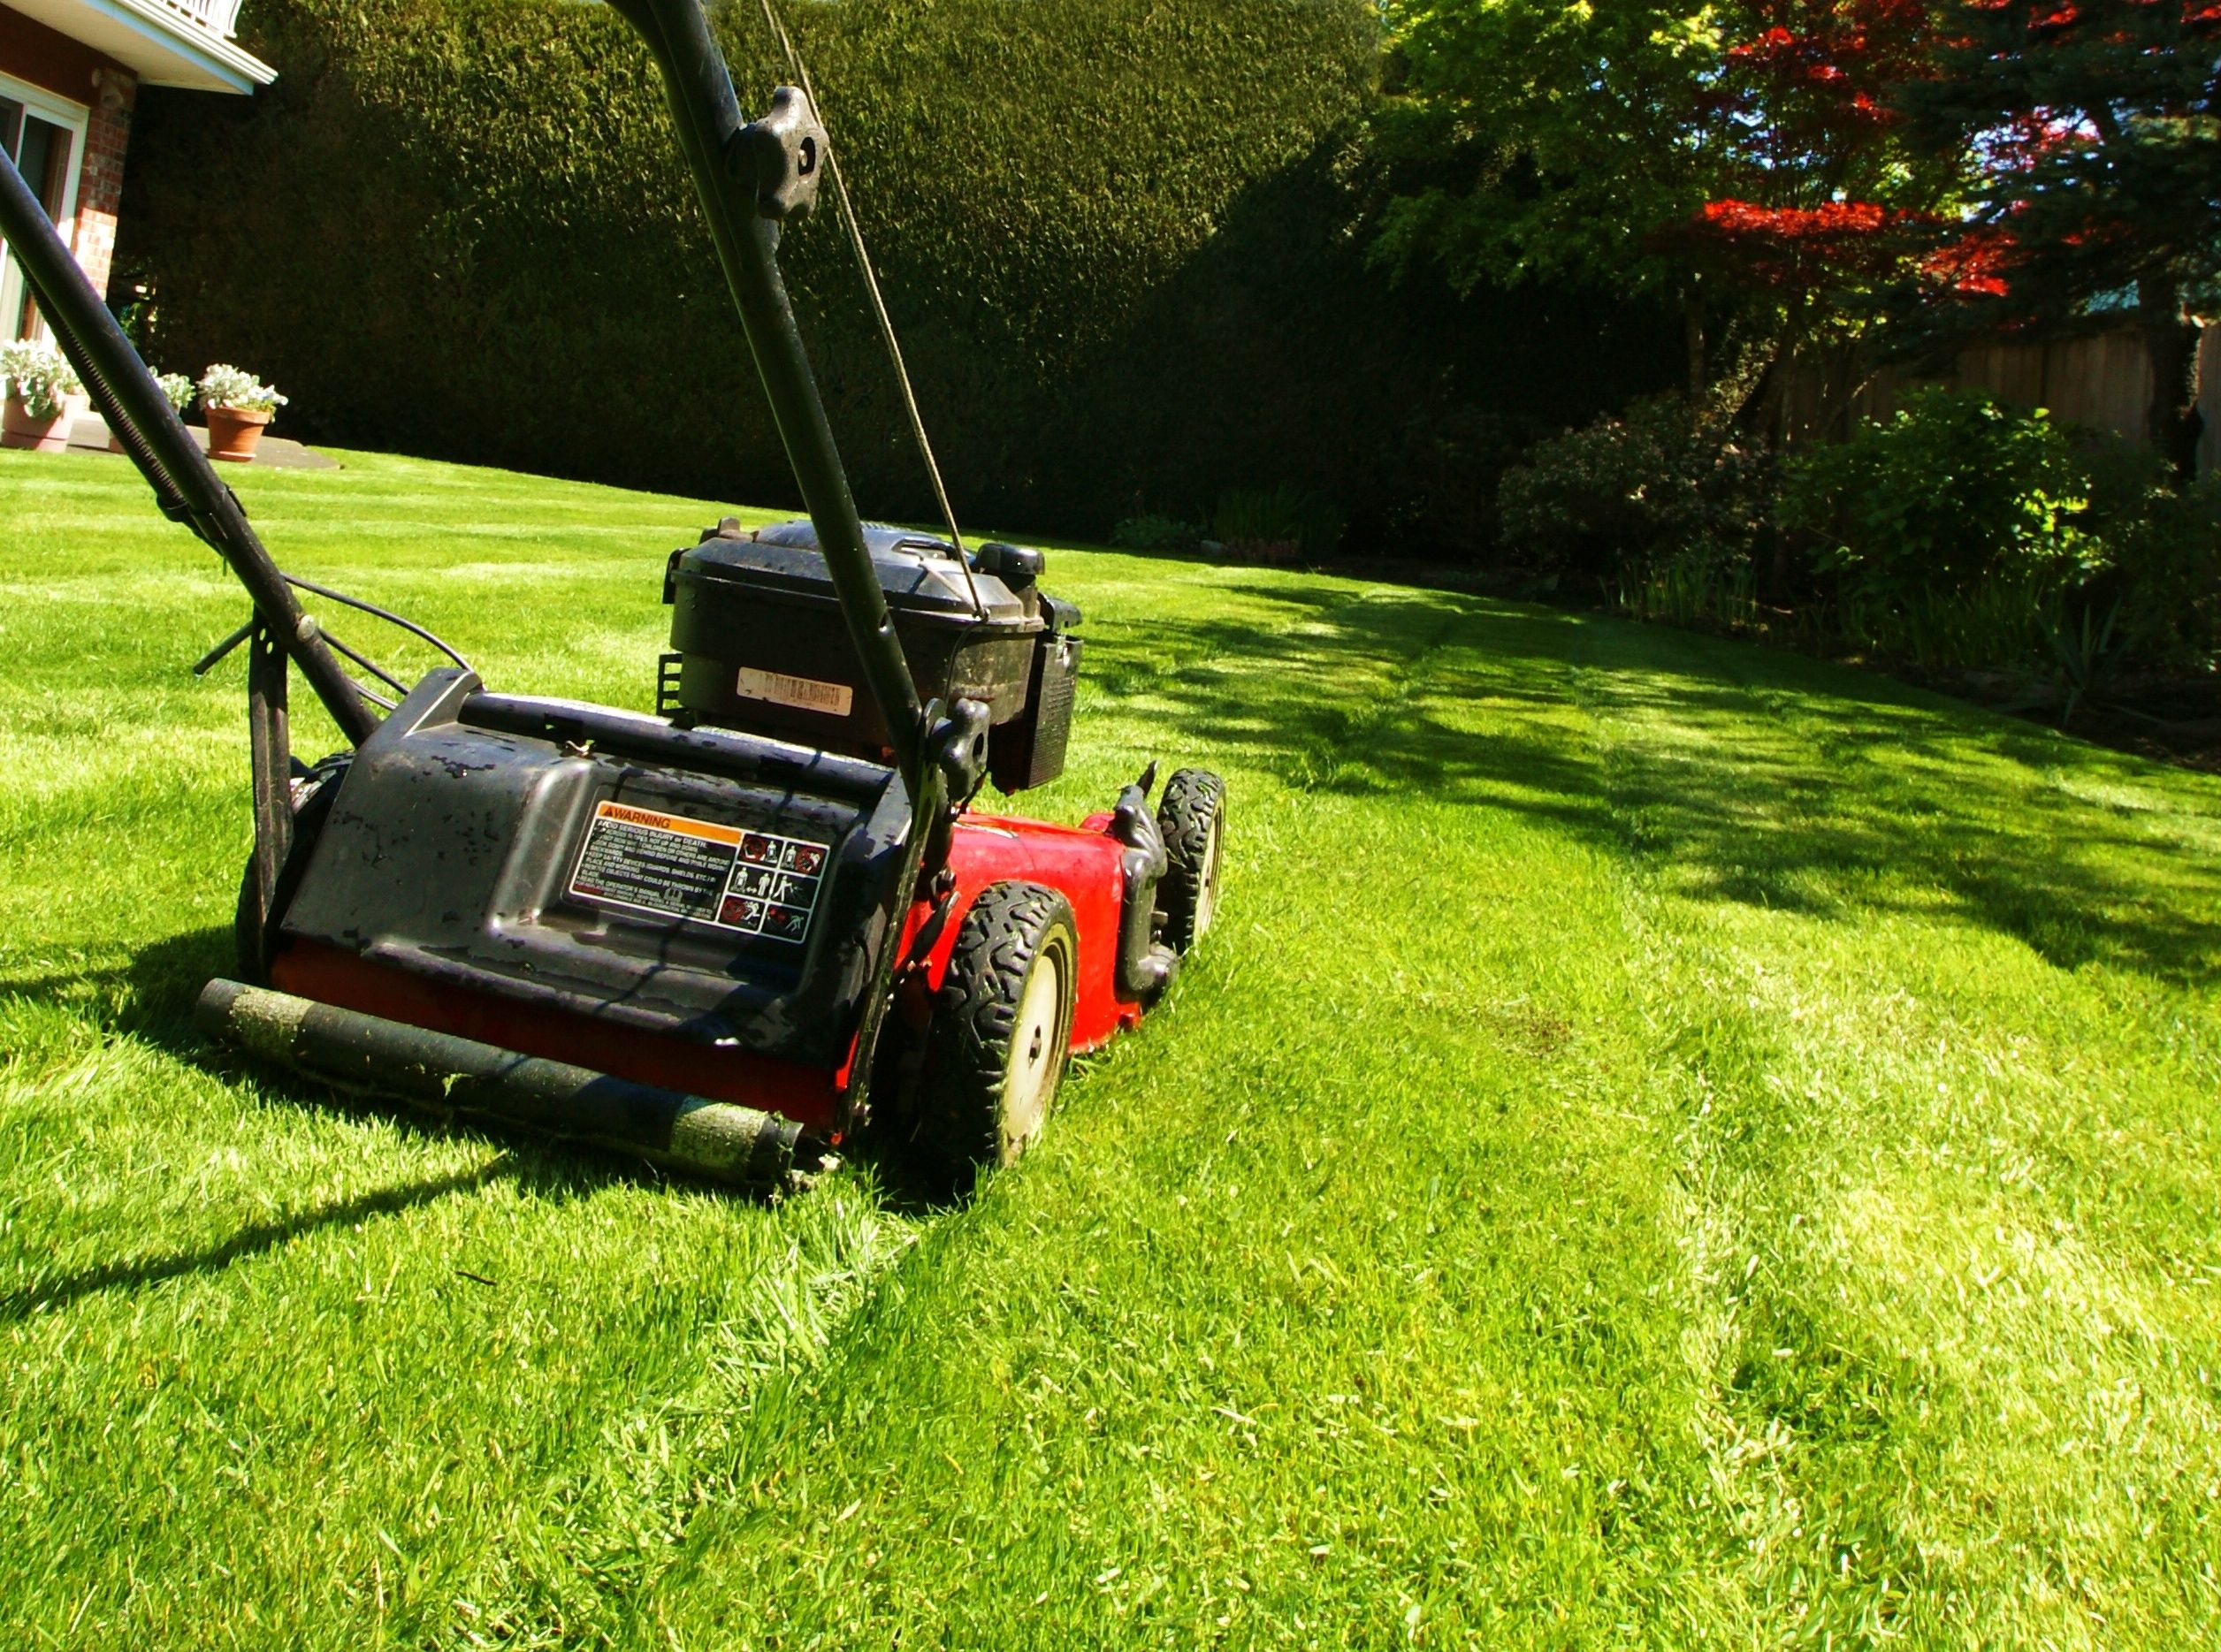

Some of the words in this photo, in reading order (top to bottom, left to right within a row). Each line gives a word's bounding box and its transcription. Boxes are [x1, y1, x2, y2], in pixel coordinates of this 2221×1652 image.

[614, 808, 671, 828] WARNING
[619, 825, 648, 834] SERIOUS
[649, 831, 673, 840] INJURY
